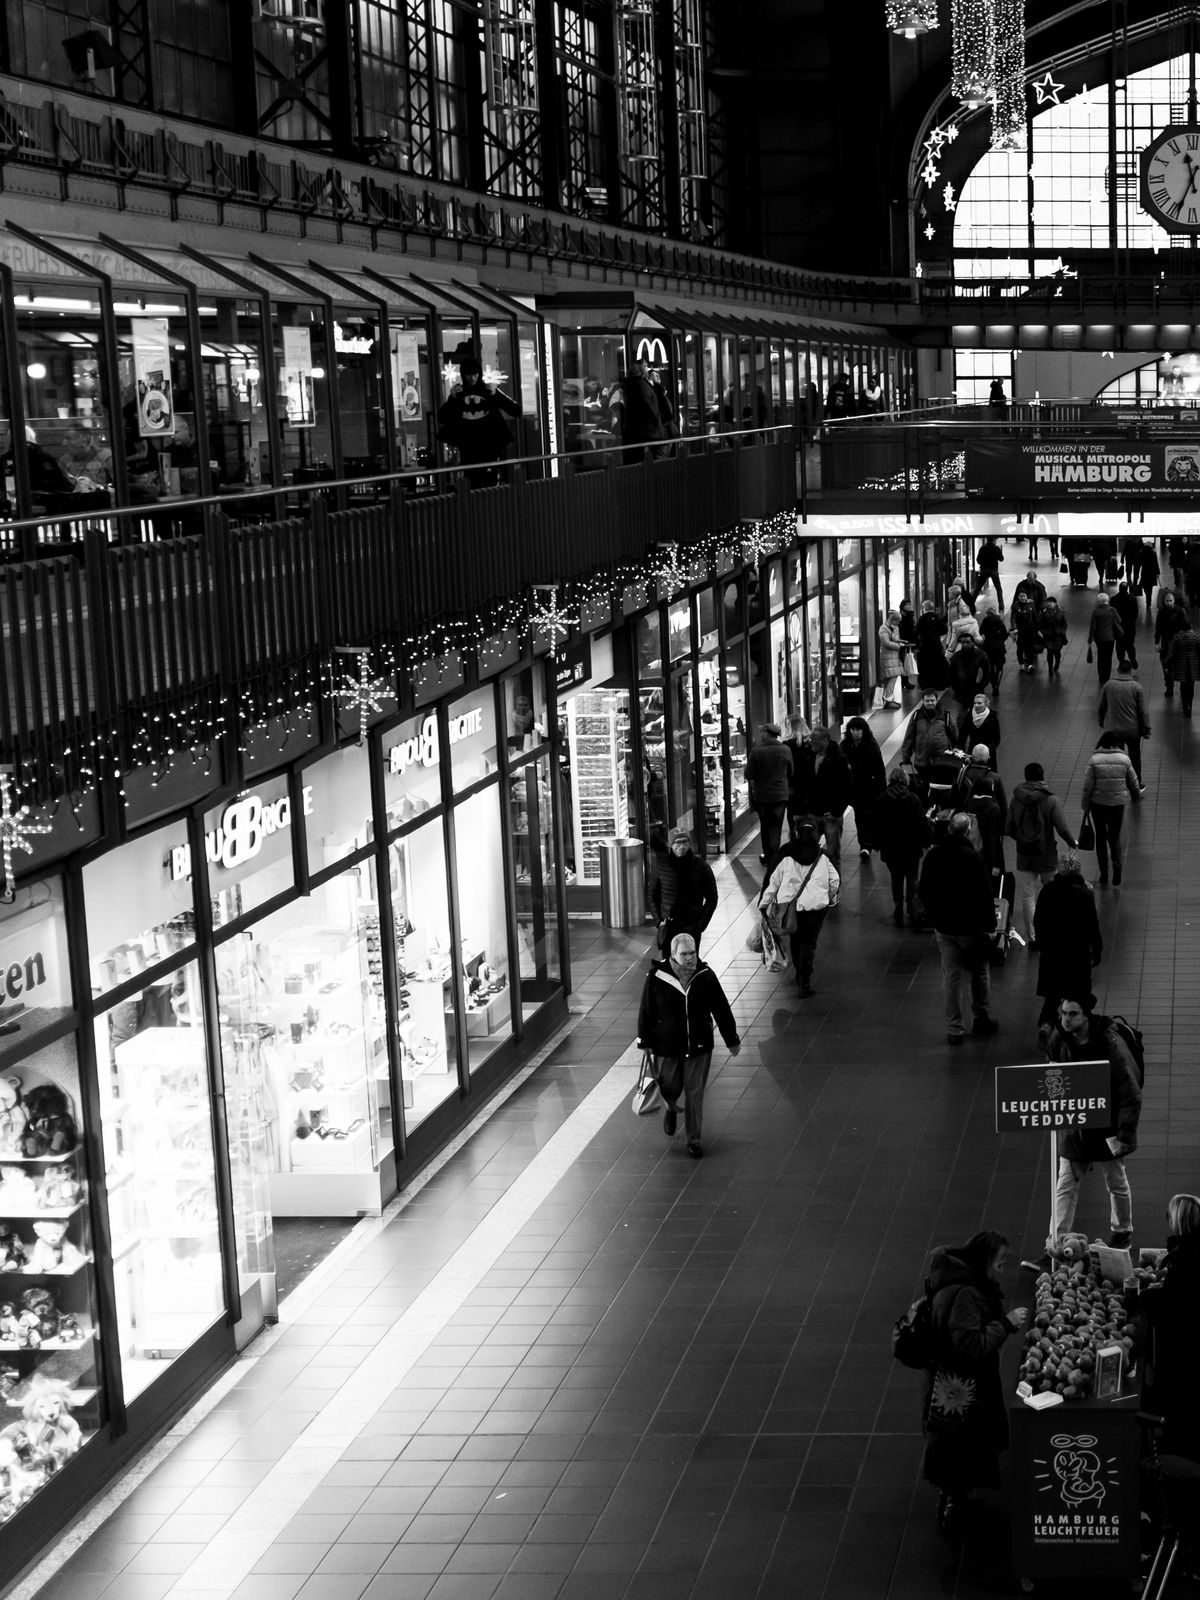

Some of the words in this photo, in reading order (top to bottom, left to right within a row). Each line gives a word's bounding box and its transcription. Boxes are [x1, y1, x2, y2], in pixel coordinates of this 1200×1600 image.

[1022, 445, 1077, 453] WILLKOMMEN
[1078, 445, 1088, 453] IN
[1090, 445, 1106, 453] DER
[1034, 455, 1083, 464] MUSICAL
[1087, 455, 1151, 464] METROPOLE
[1034, 464, 1152, 482] HAMBURG
[1002, 1097, 1107, 1113] LEUCHTFEUER
[1020, 1113, 1087, 1127] TEDDYS
[1034, 1515, 1120, 1524] HAMBURG
[1034, 1526, 1120, 1536] LEUCHTFEUER
